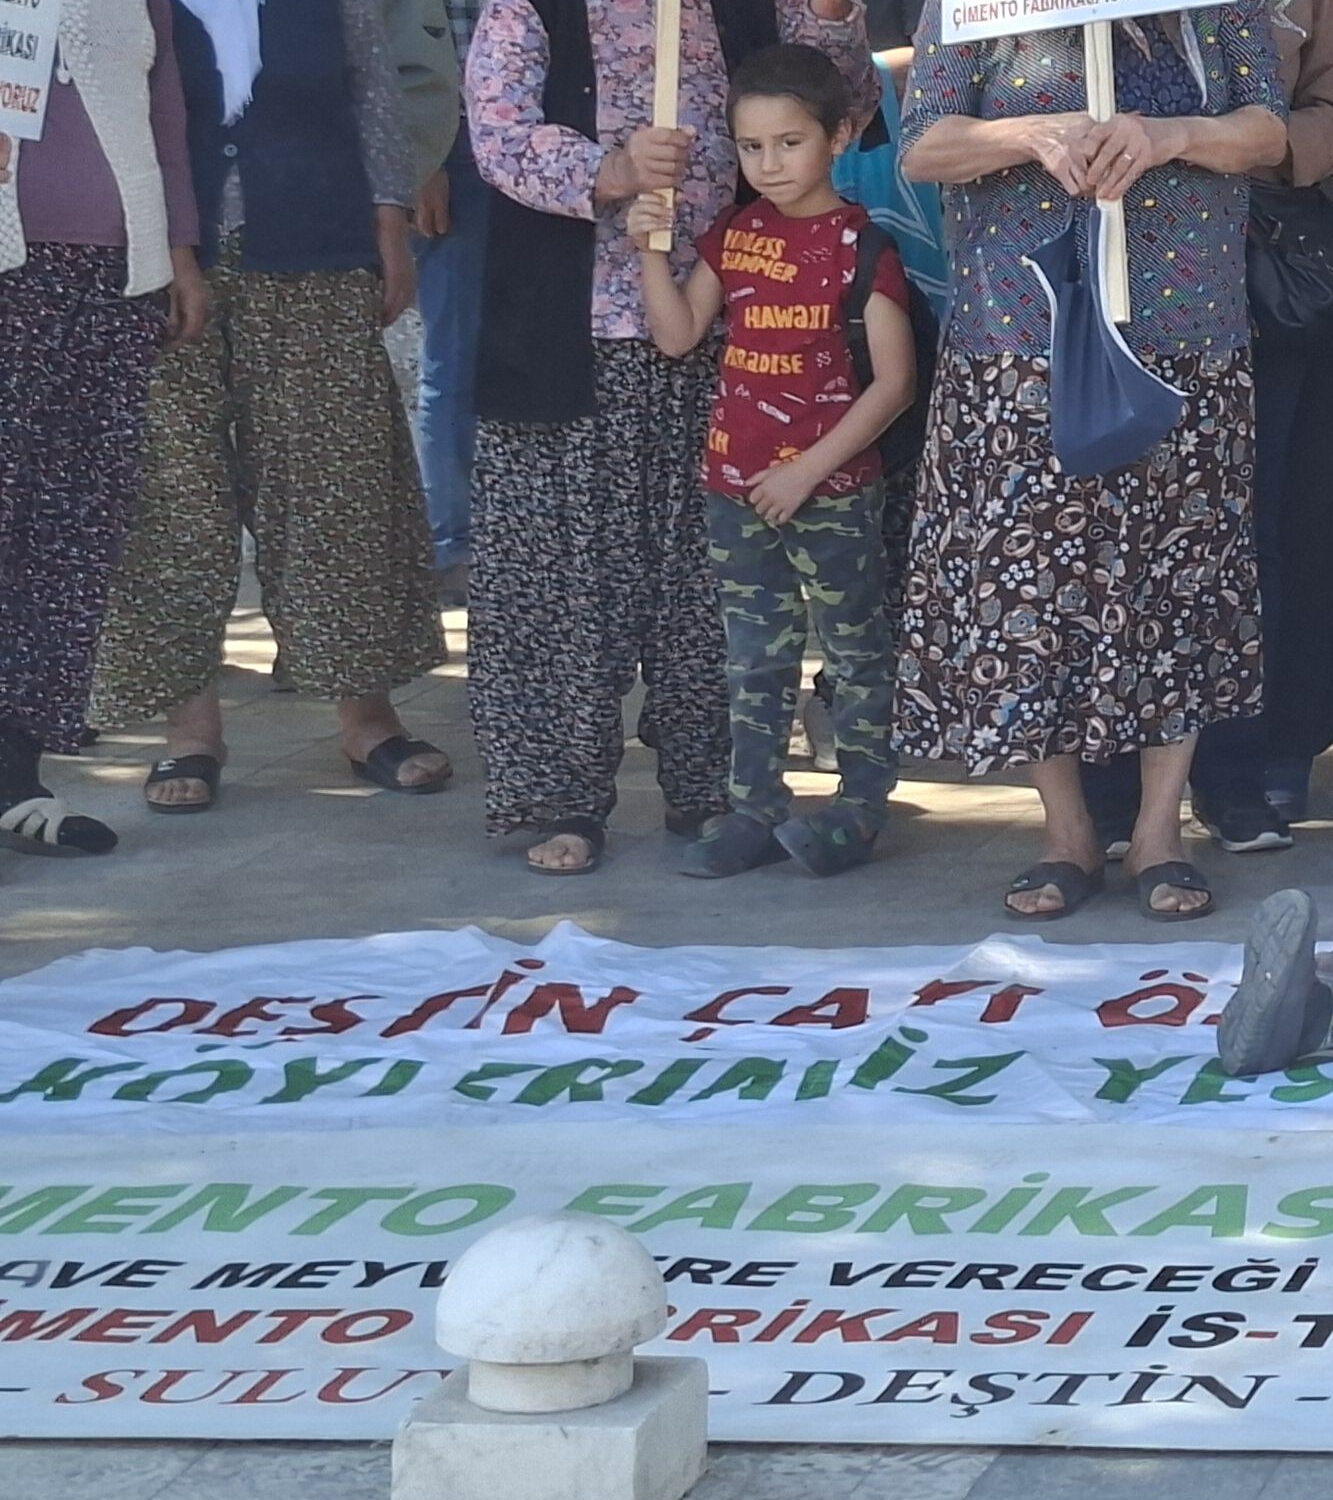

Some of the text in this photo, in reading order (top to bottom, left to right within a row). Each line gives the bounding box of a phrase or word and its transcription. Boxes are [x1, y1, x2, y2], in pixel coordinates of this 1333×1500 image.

[952, 0, 1018, 30] ÇİMENTO
[830, 1257, 1318, 1293] VERECEĞİ
[0, 1300, 413, 1344] MENTO
[751, 1364, 1280, 1418] DEŞTİN
